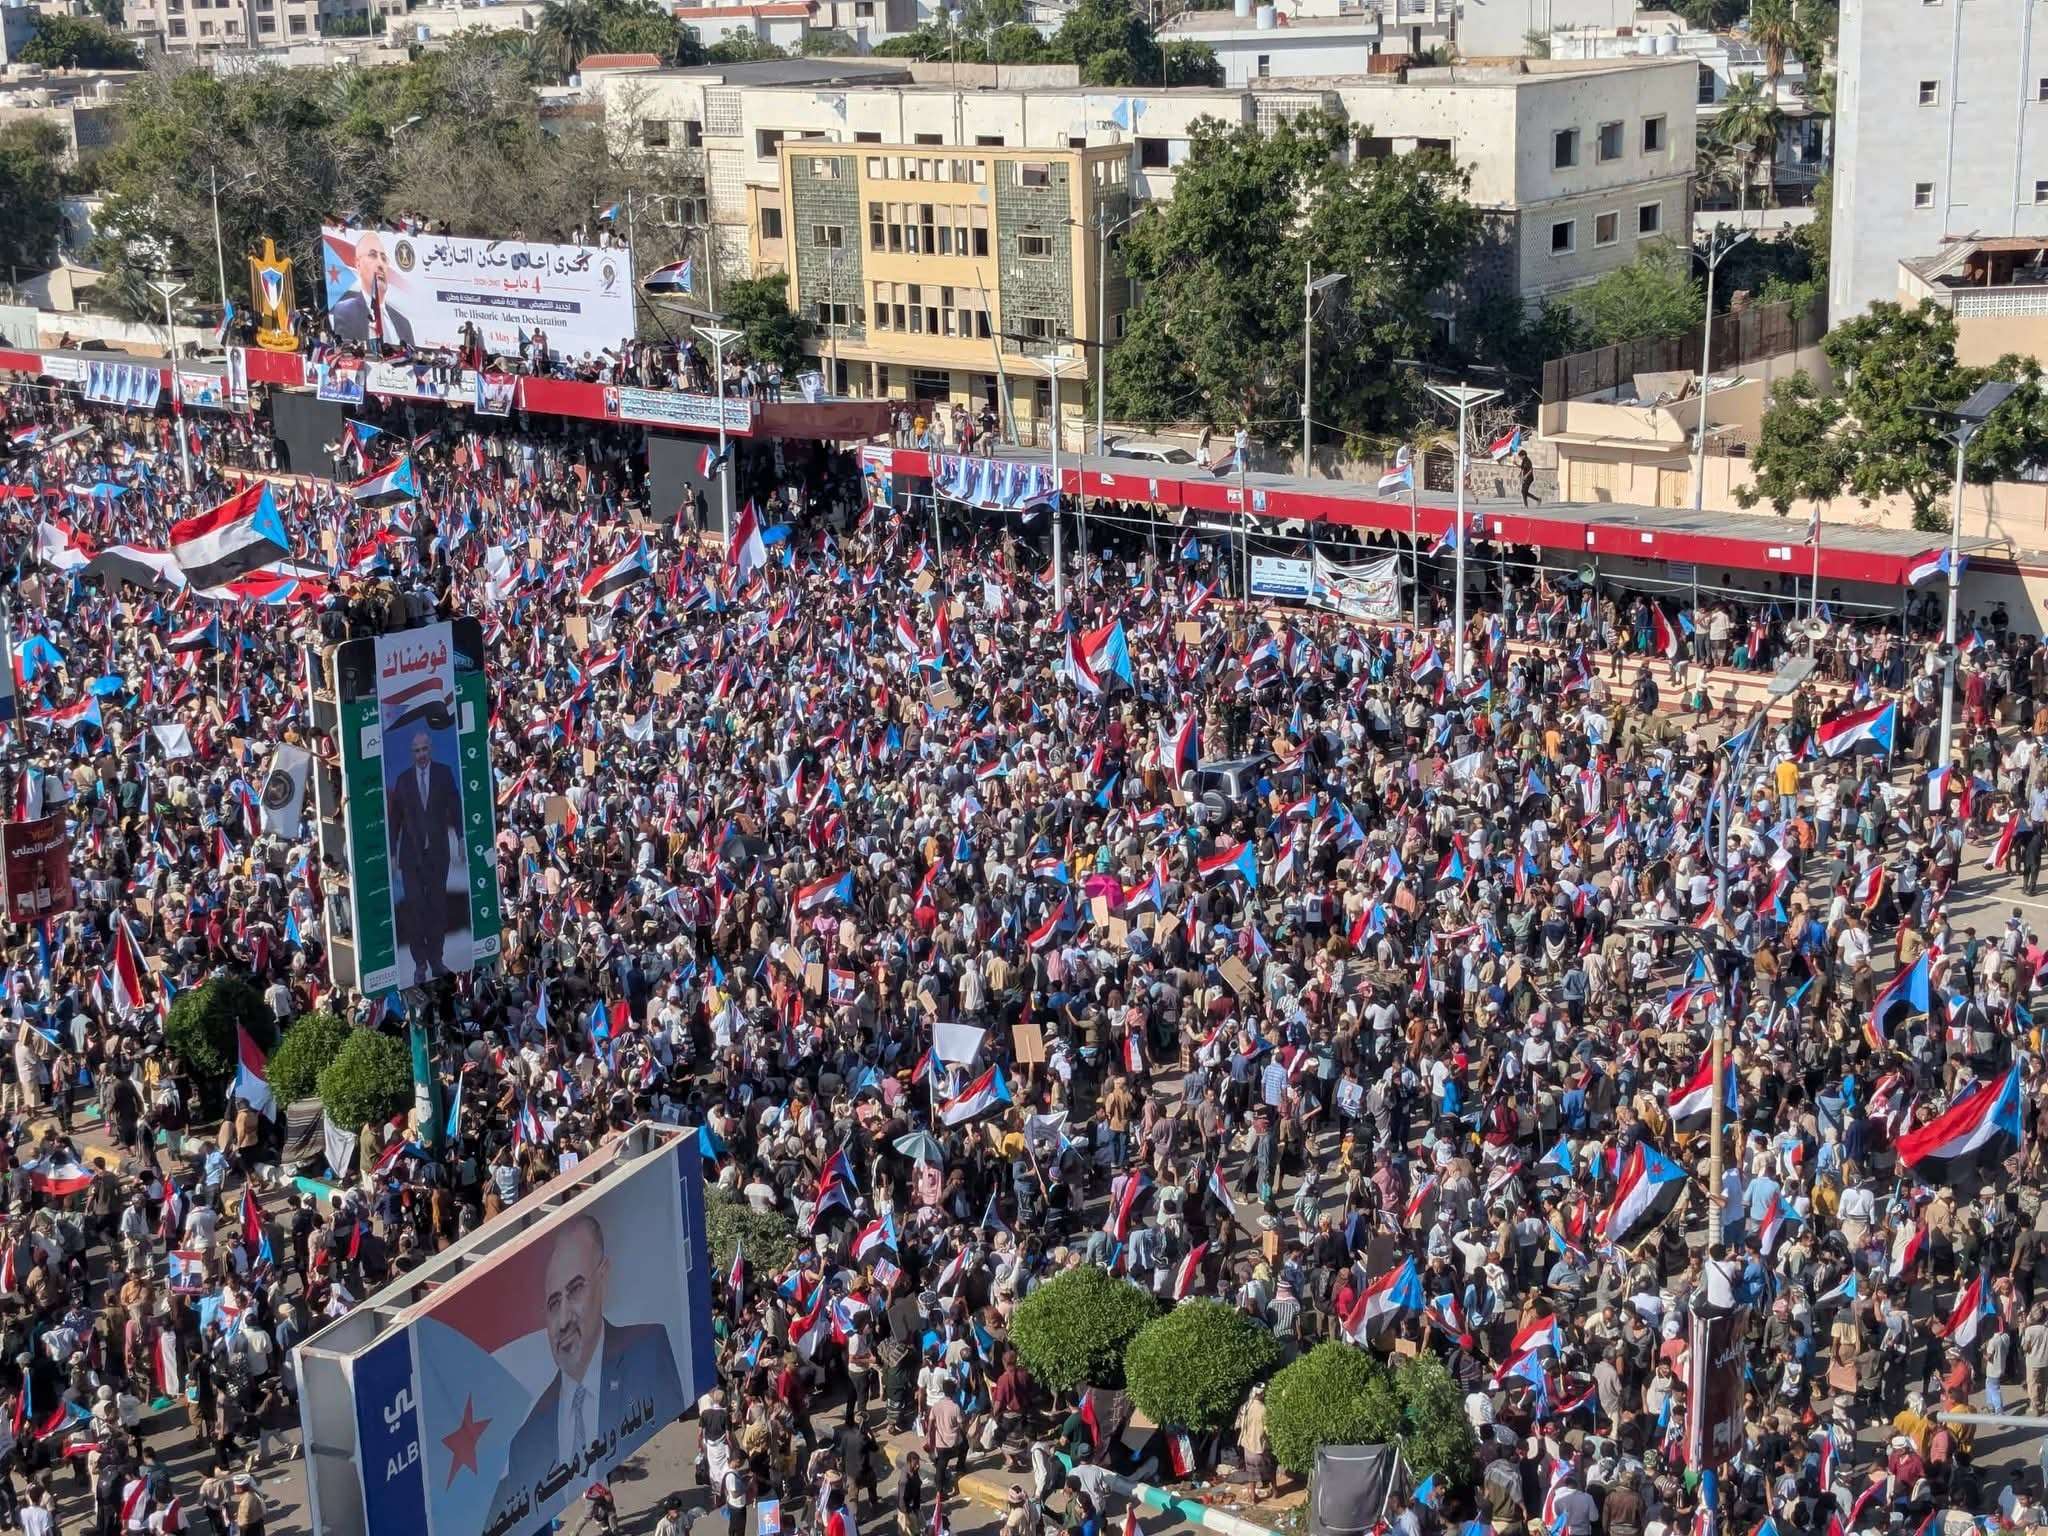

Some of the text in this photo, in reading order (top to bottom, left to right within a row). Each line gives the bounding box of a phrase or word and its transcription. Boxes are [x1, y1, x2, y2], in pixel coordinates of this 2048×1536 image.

[422, 244, 473, 272] التاريخي
[477, 251, 508, 268] عدن
[503, 273, 529, 292] مايو
[531, 275, 541, 294] 4
[455, 308, 568, 327] The Historic Aden Declaration
[382, 639, 448, 679] فوضناك
[620, 1395, 655, 1438] بالله
[386, 1440, 421, 1482] ALB
[480, 1483, 530, 1536] ننتص
